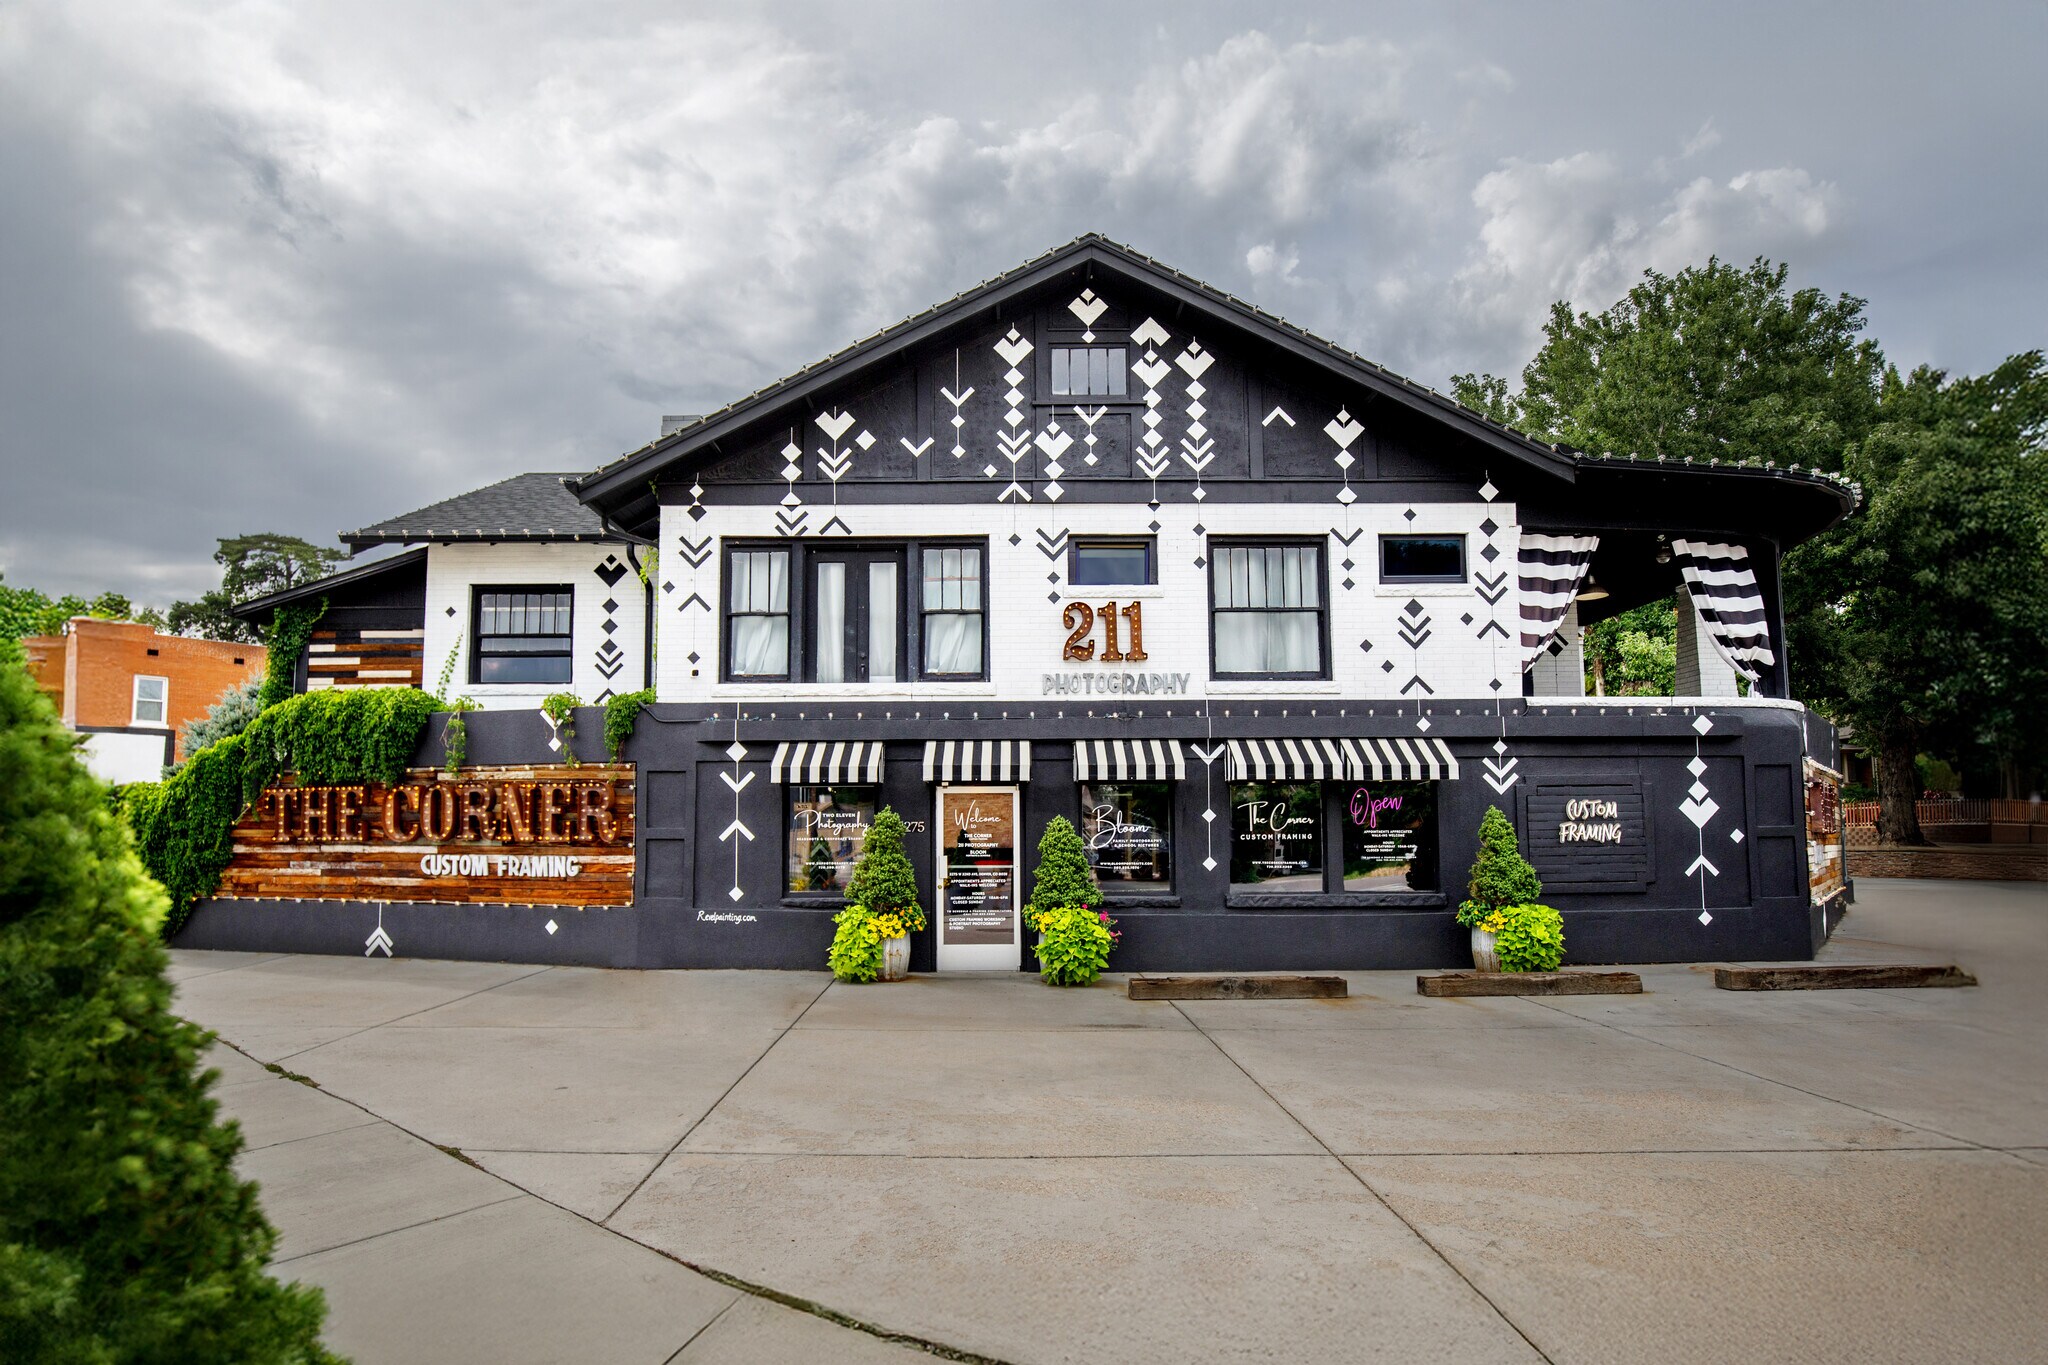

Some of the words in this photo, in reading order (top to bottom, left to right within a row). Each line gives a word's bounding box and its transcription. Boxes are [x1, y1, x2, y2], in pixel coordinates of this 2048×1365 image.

[1063, 601, 1148, 662] 211
[1042, 673, 1190, 696] PHOTOGRAPHY
[263, 785, 368, 842] THE
[382, 781, 621, 844] CORNER
[794, 809, 870, 837] Photography
[954, 799, 1002, 831] Welcome
[1237, 800, 1269, 832] The
[1269, 802, 1314, 832] Corner
[1350, 787, 1403, 829] Open
[1565, 798, 1618, 820] CUSTOM
[900, 820, 925, 833] 275
[1090, 804, 1150, 849] Bloom
[1559, 821, 1622, 843] FRAMING
[420, 854, 489, 877] CUSTOM
[497, 855, 581, 879] FRAMING
